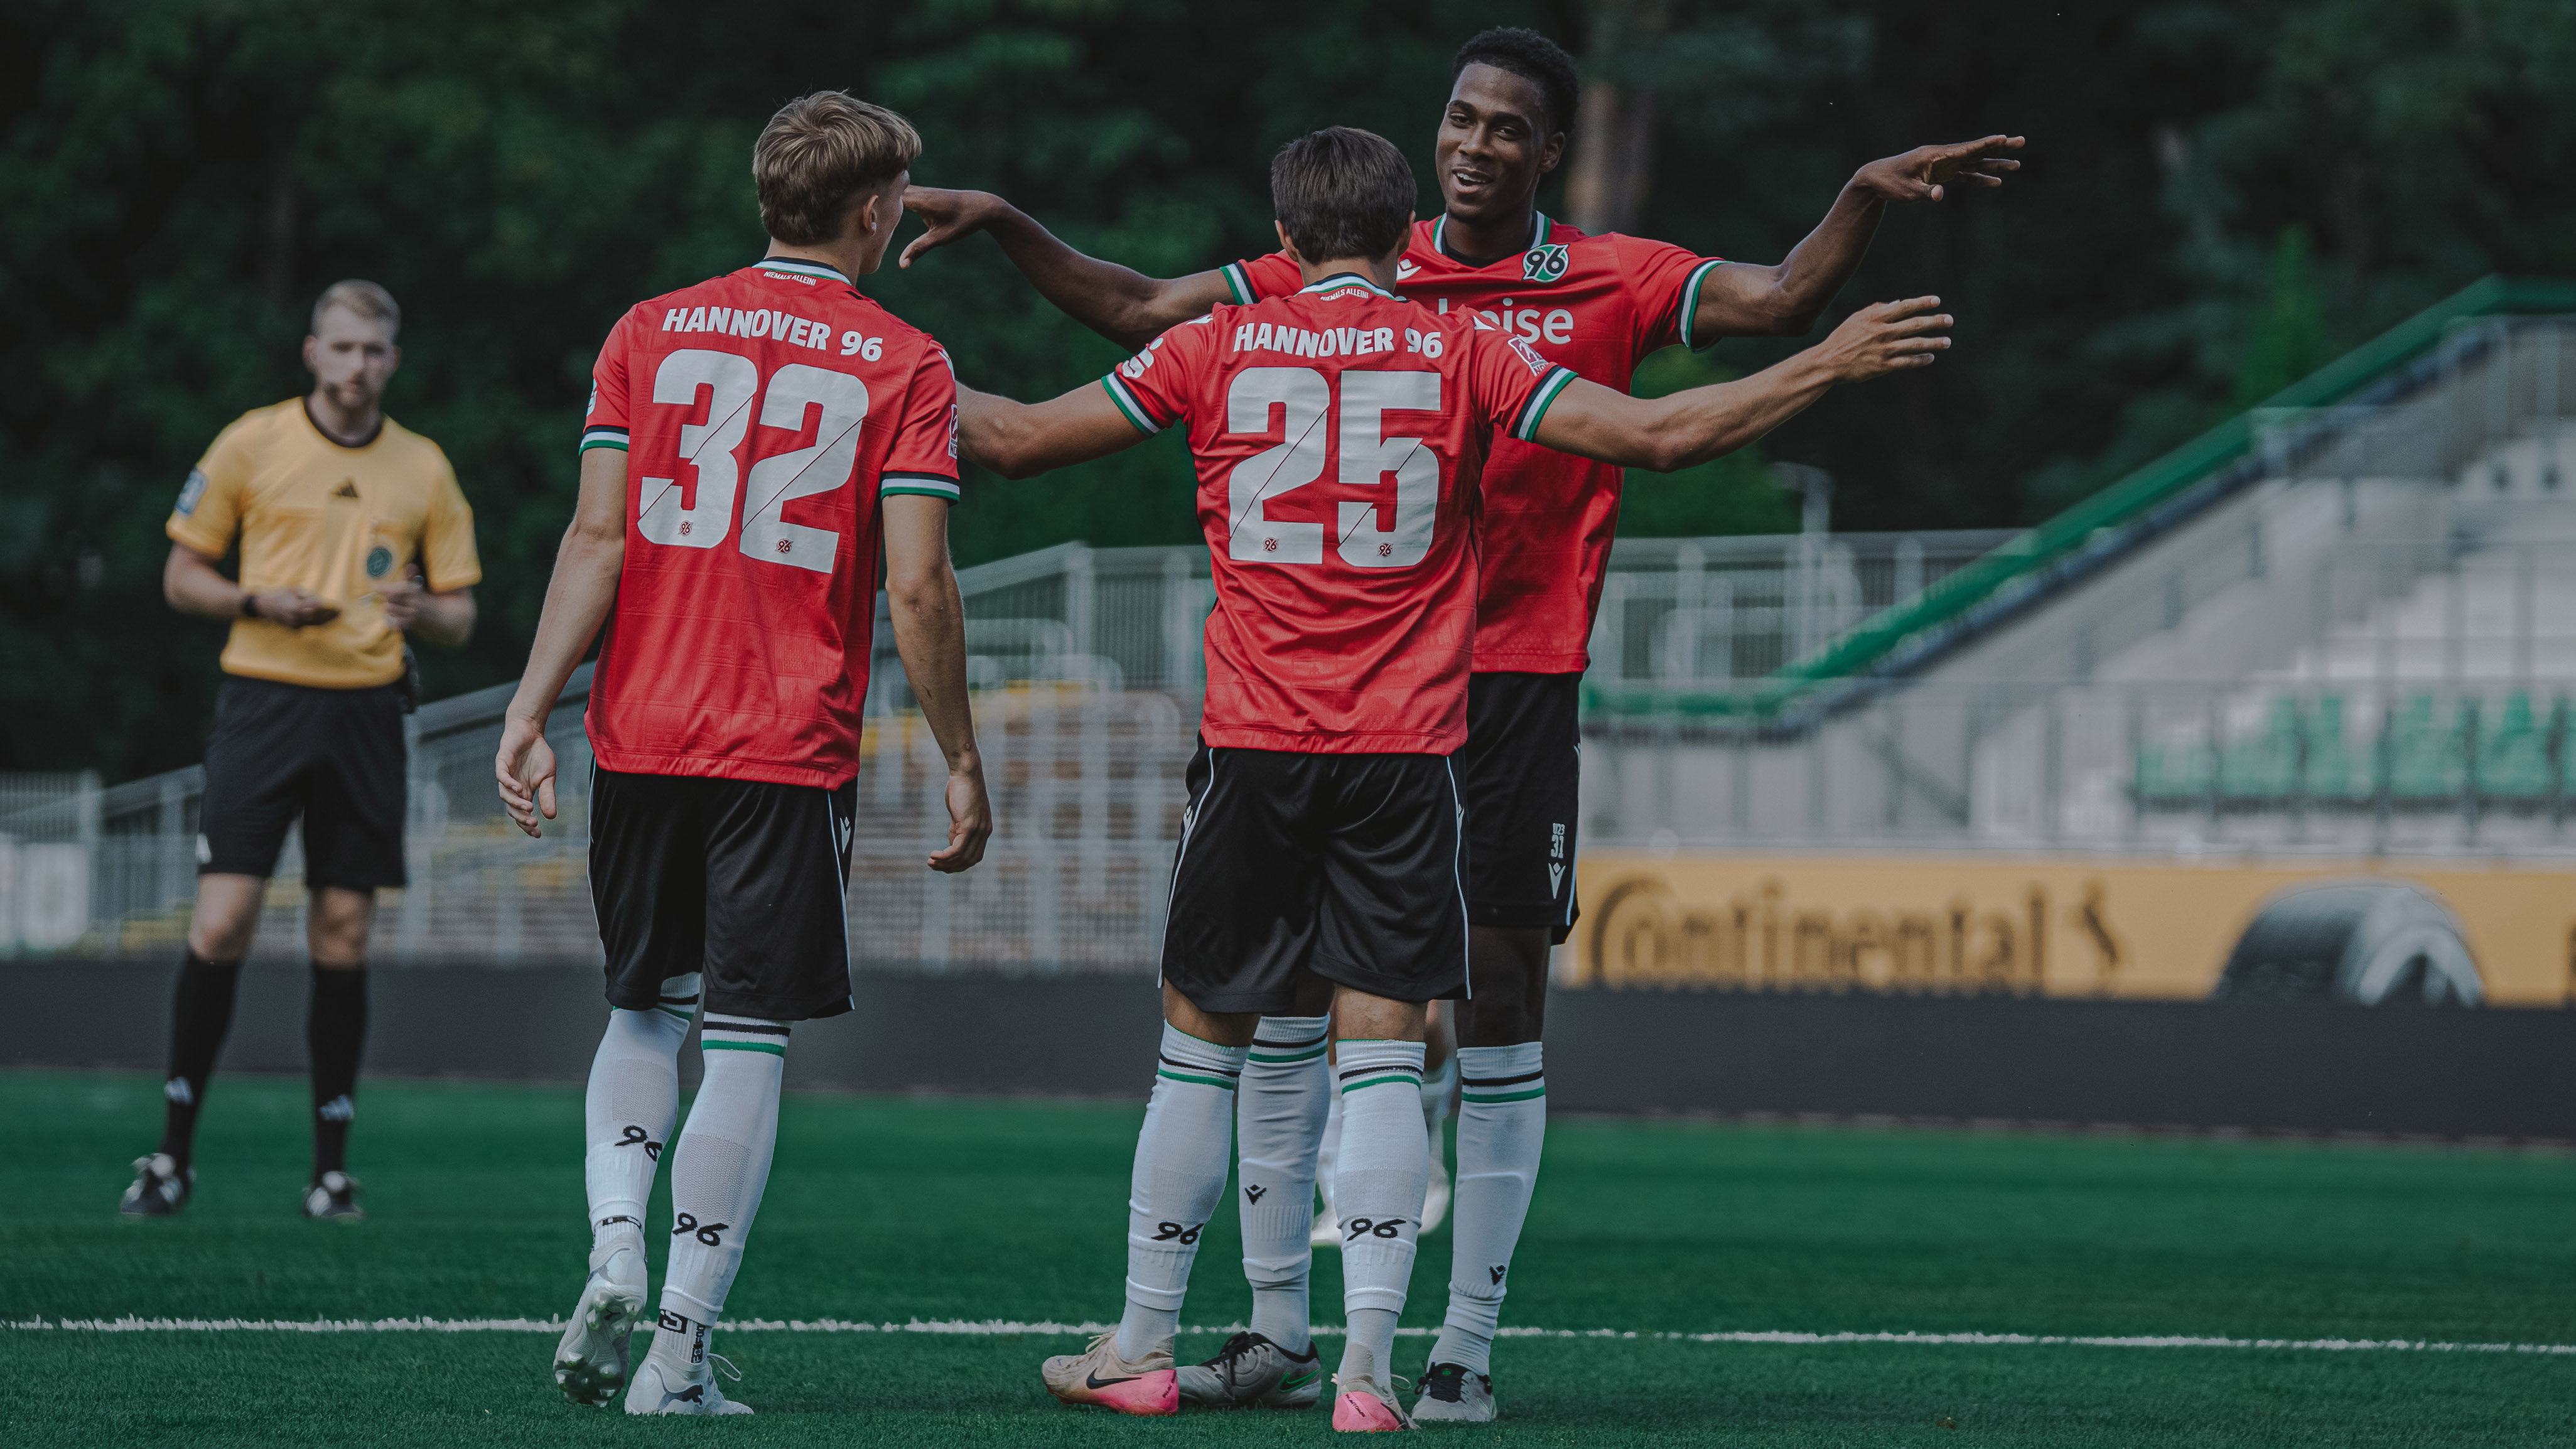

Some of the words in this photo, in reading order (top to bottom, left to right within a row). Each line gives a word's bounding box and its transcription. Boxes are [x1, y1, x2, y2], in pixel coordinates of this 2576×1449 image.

[1523, 245, 1568, 280] 96
[662, 306, 831, 352] HANNOVER
[840, 330, 883, 362] 96
[1233, 322, 1394, 358] HANNOVER
[1404, 328, 1443, 359] 96
[637, 348, 870, 574] 32
[1227, 367, 1441, 568] 25
[680, 521, 691, 535] 96
[777, 539, 792, 553] 96
[1264, 537, 1278, 552] 96
[1379, 542, 1392, 557] 96
[1553, 822, 1565, 836] U23
[1551, 834, 1564, 859] 31
[613, 1124, 663, 1162] 96
[672, 1212, 729, 1247] 96
[1151, 1220, 1205, 1245] 96
[1346, 1217, 1407, 1242] 96
